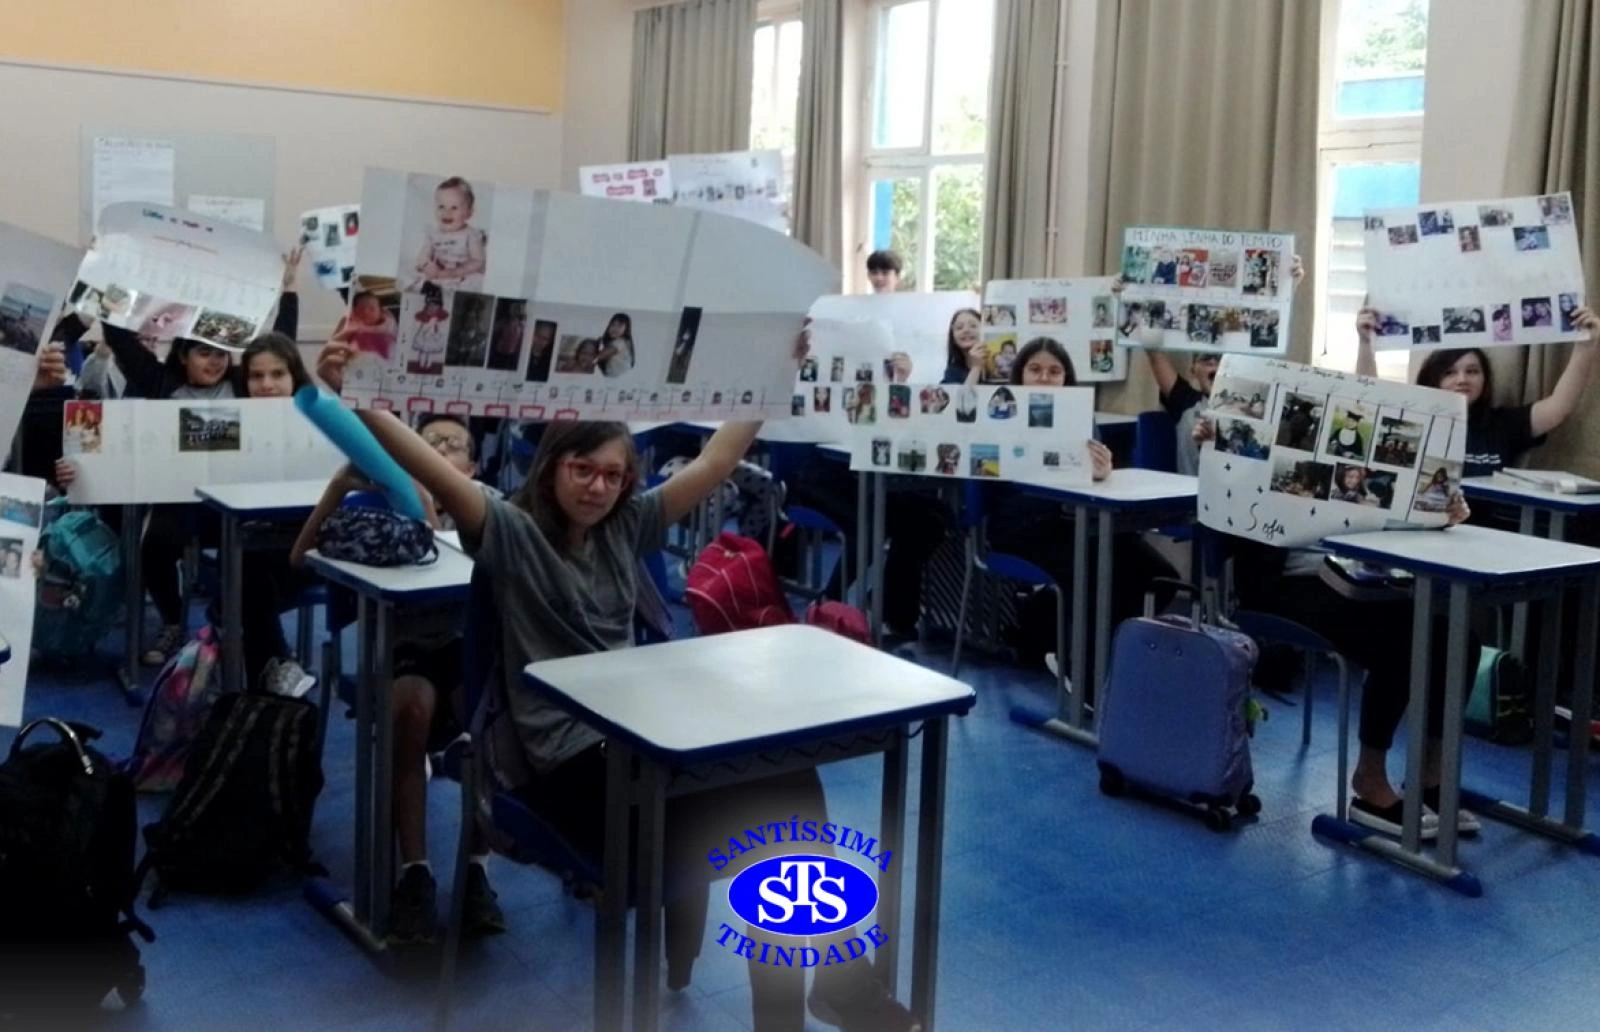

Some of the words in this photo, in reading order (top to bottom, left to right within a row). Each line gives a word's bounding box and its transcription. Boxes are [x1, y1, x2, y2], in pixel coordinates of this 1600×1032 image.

[1132, 229, 1177, 244] MINHA
[1182, 231, 1219, 245] LINHA
[1222, 232, 1235, 246] DO
[1240, 233, 1283, 249] TEMPO
